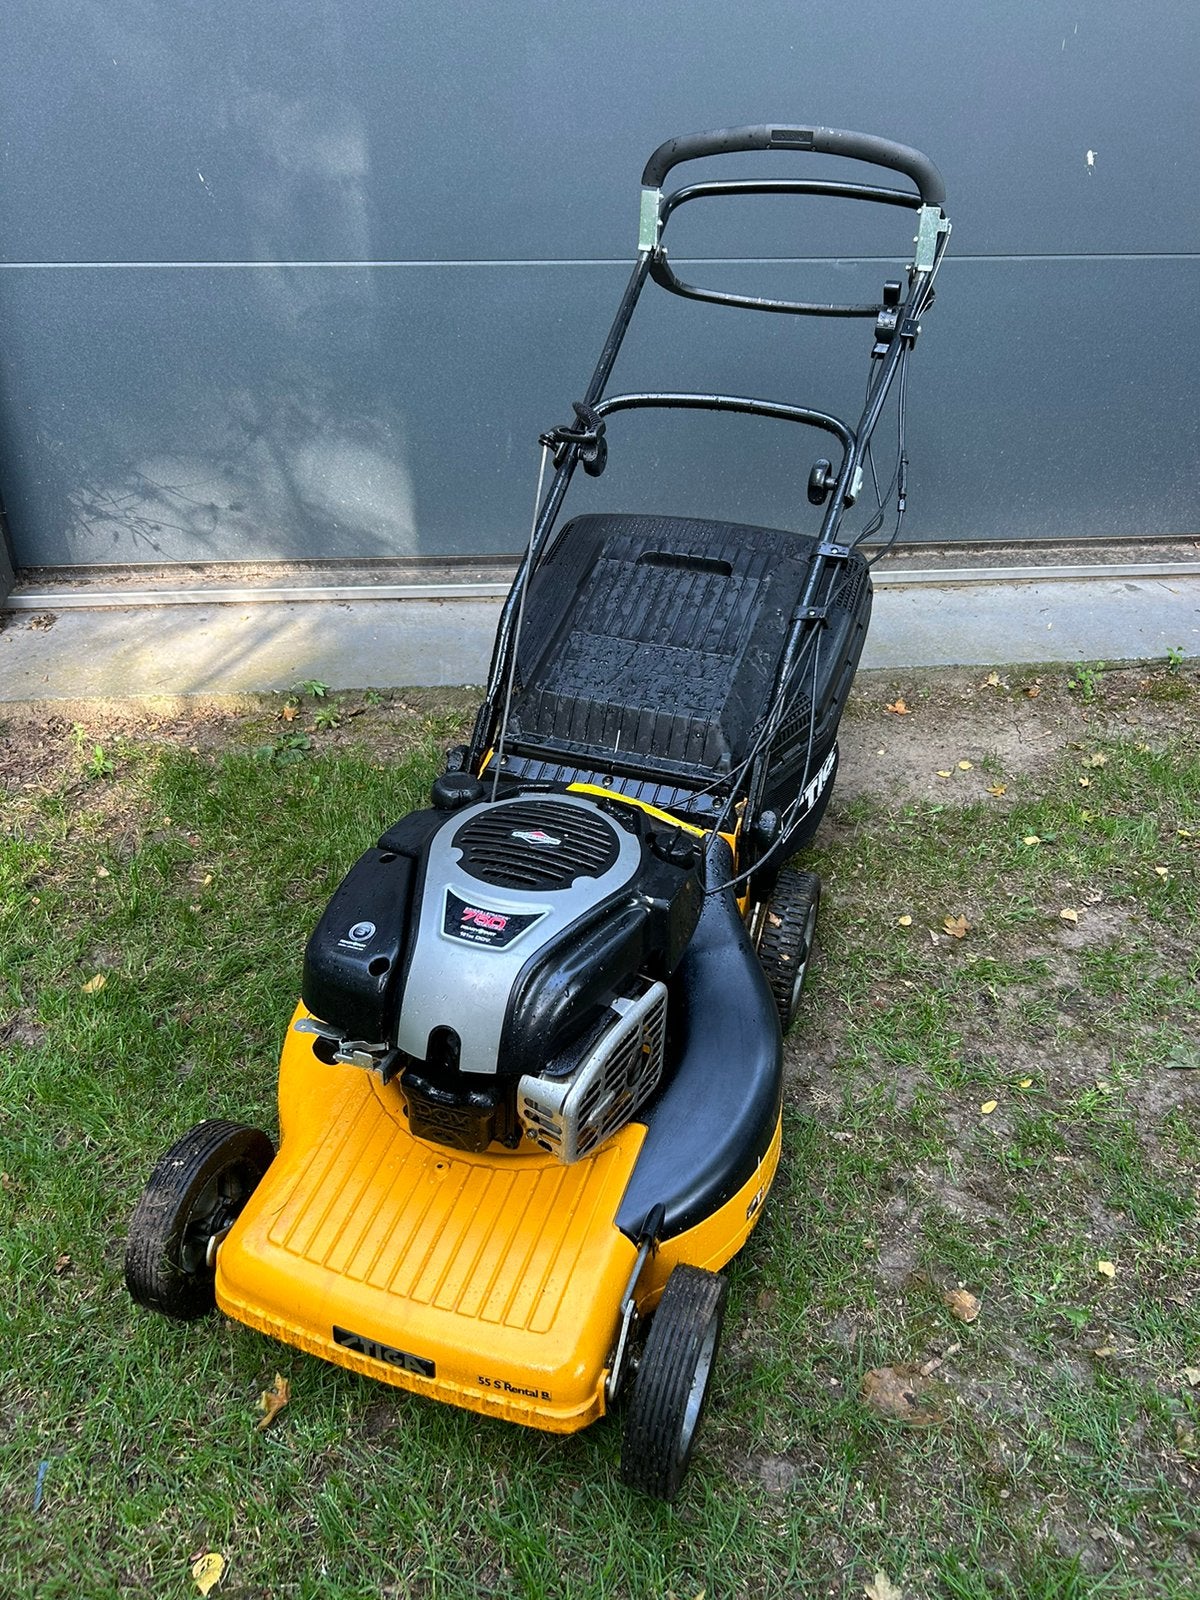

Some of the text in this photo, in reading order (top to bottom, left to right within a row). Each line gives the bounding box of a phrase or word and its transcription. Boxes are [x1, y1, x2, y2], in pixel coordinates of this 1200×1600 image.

[340, 1336, 427, 1376] STIGA
[478, 1376, 491, 1387] 55
[493, 1380, 502, 1389] S
[503, 1382, 539, 1398] Rental
